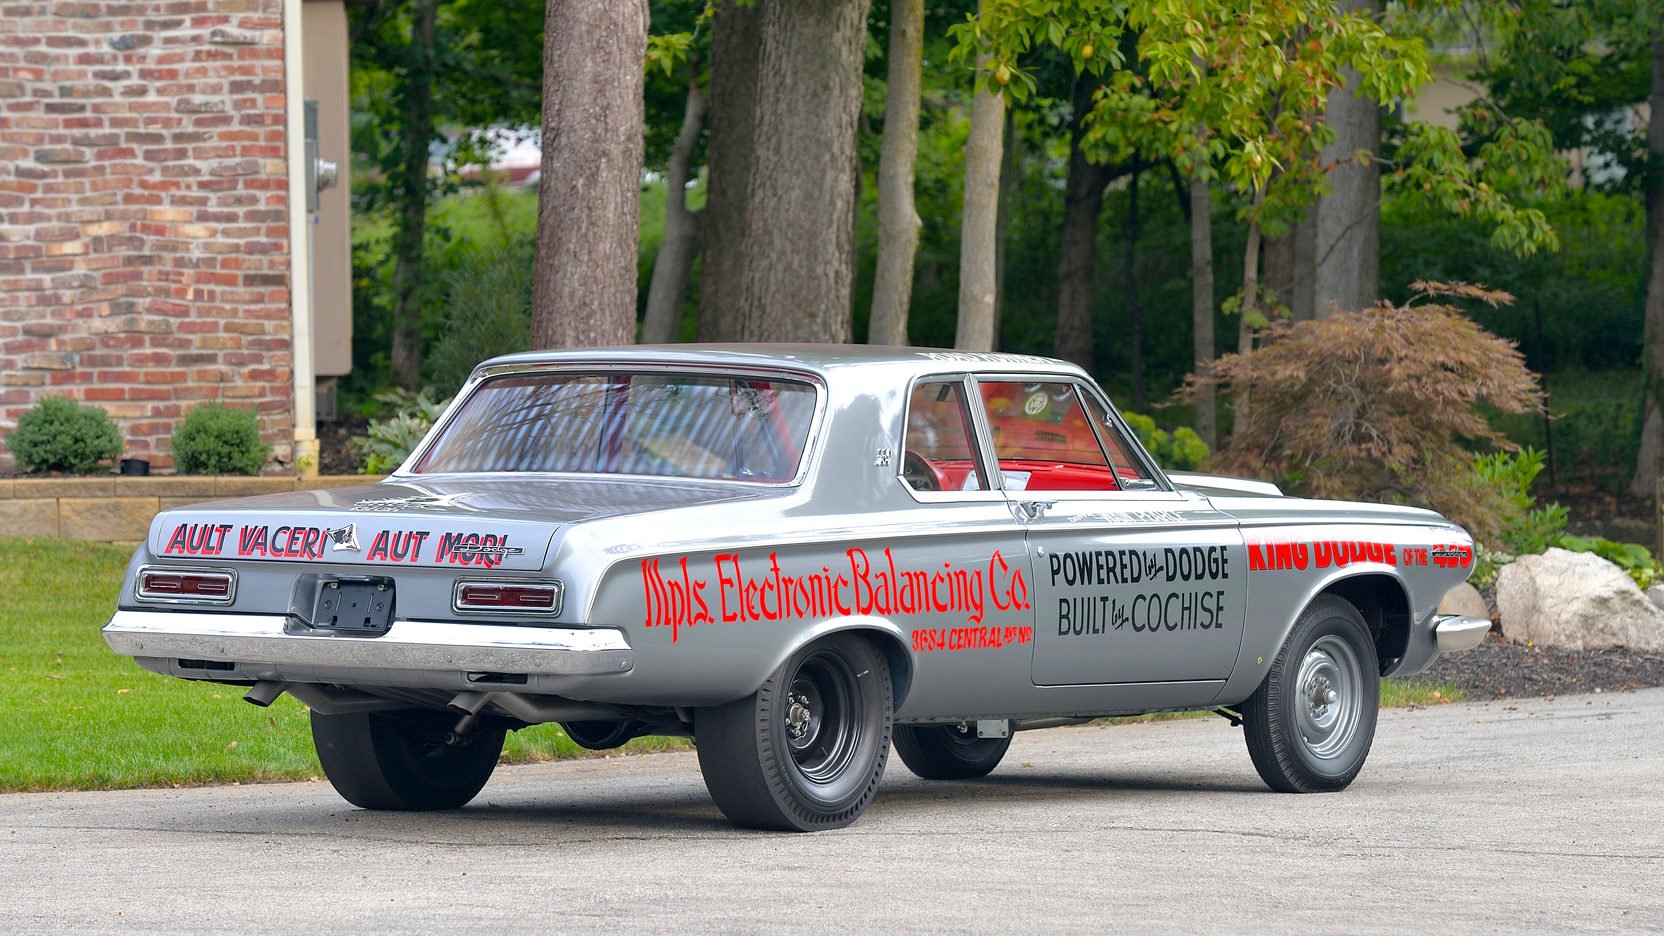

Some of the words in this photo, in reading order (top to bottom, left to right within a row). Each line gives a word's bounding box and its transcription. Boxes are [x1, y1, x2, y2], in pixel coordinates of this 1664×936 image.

[165, 524, 233, 555] AULT
[367, 530, 430, 562] AUT
[435, 532, 509, 569] MORI
[1049, 549, 1142, 586] POWERED
[1142, 550, 1164, 581] by
[1164, 546, 1229, 582] DODGE
[1247, 541, 1309, 570] KING
[1313, 540, 1397, 568] DODGE
[1403, 548, 1413, 566] OF
[1414, 548, 1428, 566] THE
[641, 556, 715, 643] Mpls.
[714, 552, 849, 623] Electronic
[846, 547, 984, 628] Balancing
[989, 550, 1031, 611] Co.
[1058, 596, 1109, 636] BUILT
[1111, 599, 1130, 631] by
[1132, 591, 1225, 632] COCHISE
[911, 628, 946, 652] 3684
[948, 627, 1003, 651] CENTRAL
